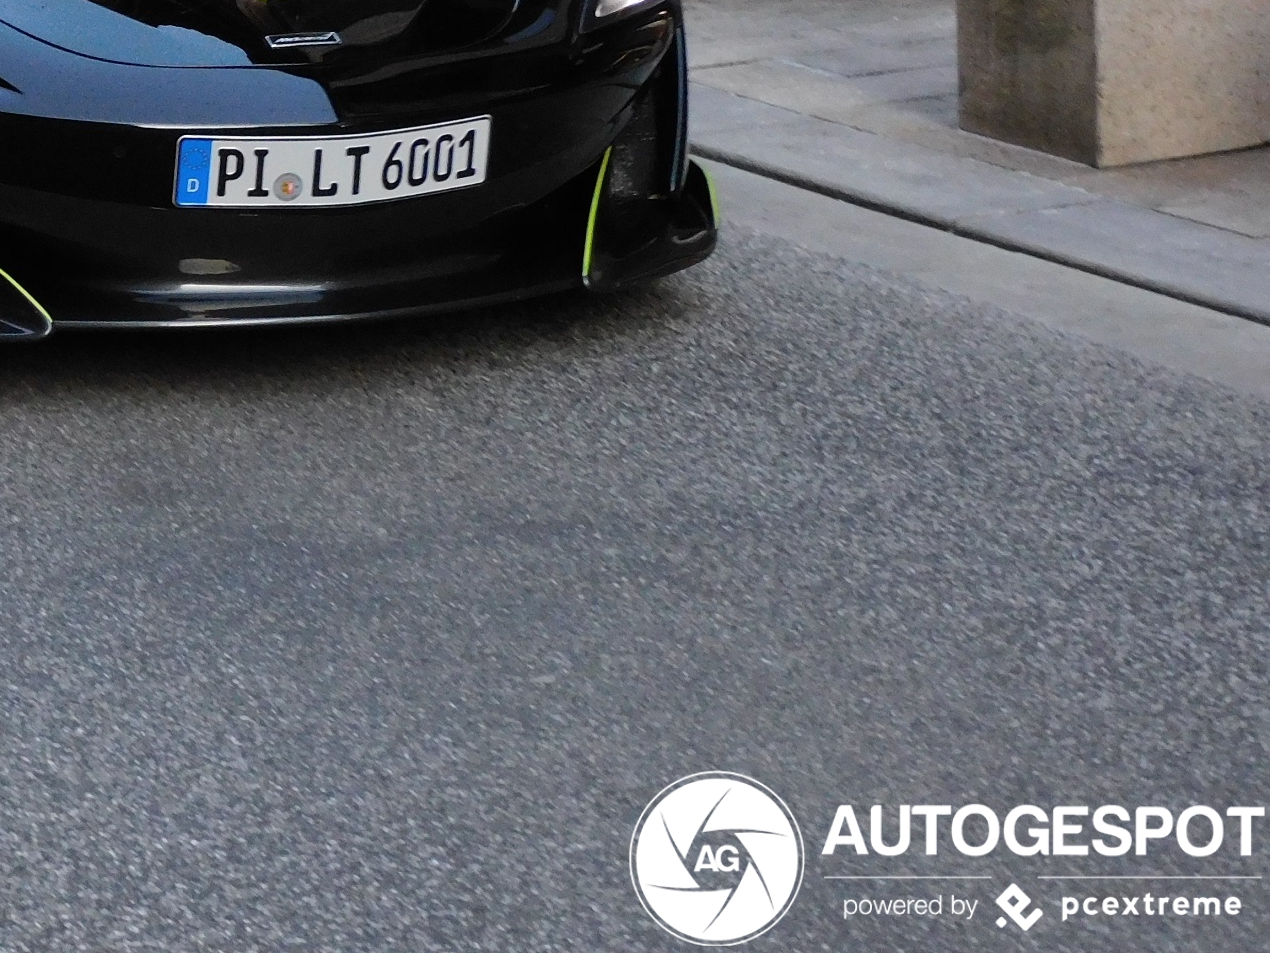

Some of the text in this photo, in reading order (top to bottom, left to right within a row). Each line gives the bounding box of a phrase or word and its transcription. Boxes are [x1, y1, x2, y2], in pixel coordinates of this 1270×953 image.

[187, 129, 477, 198] D PI LT 6001
